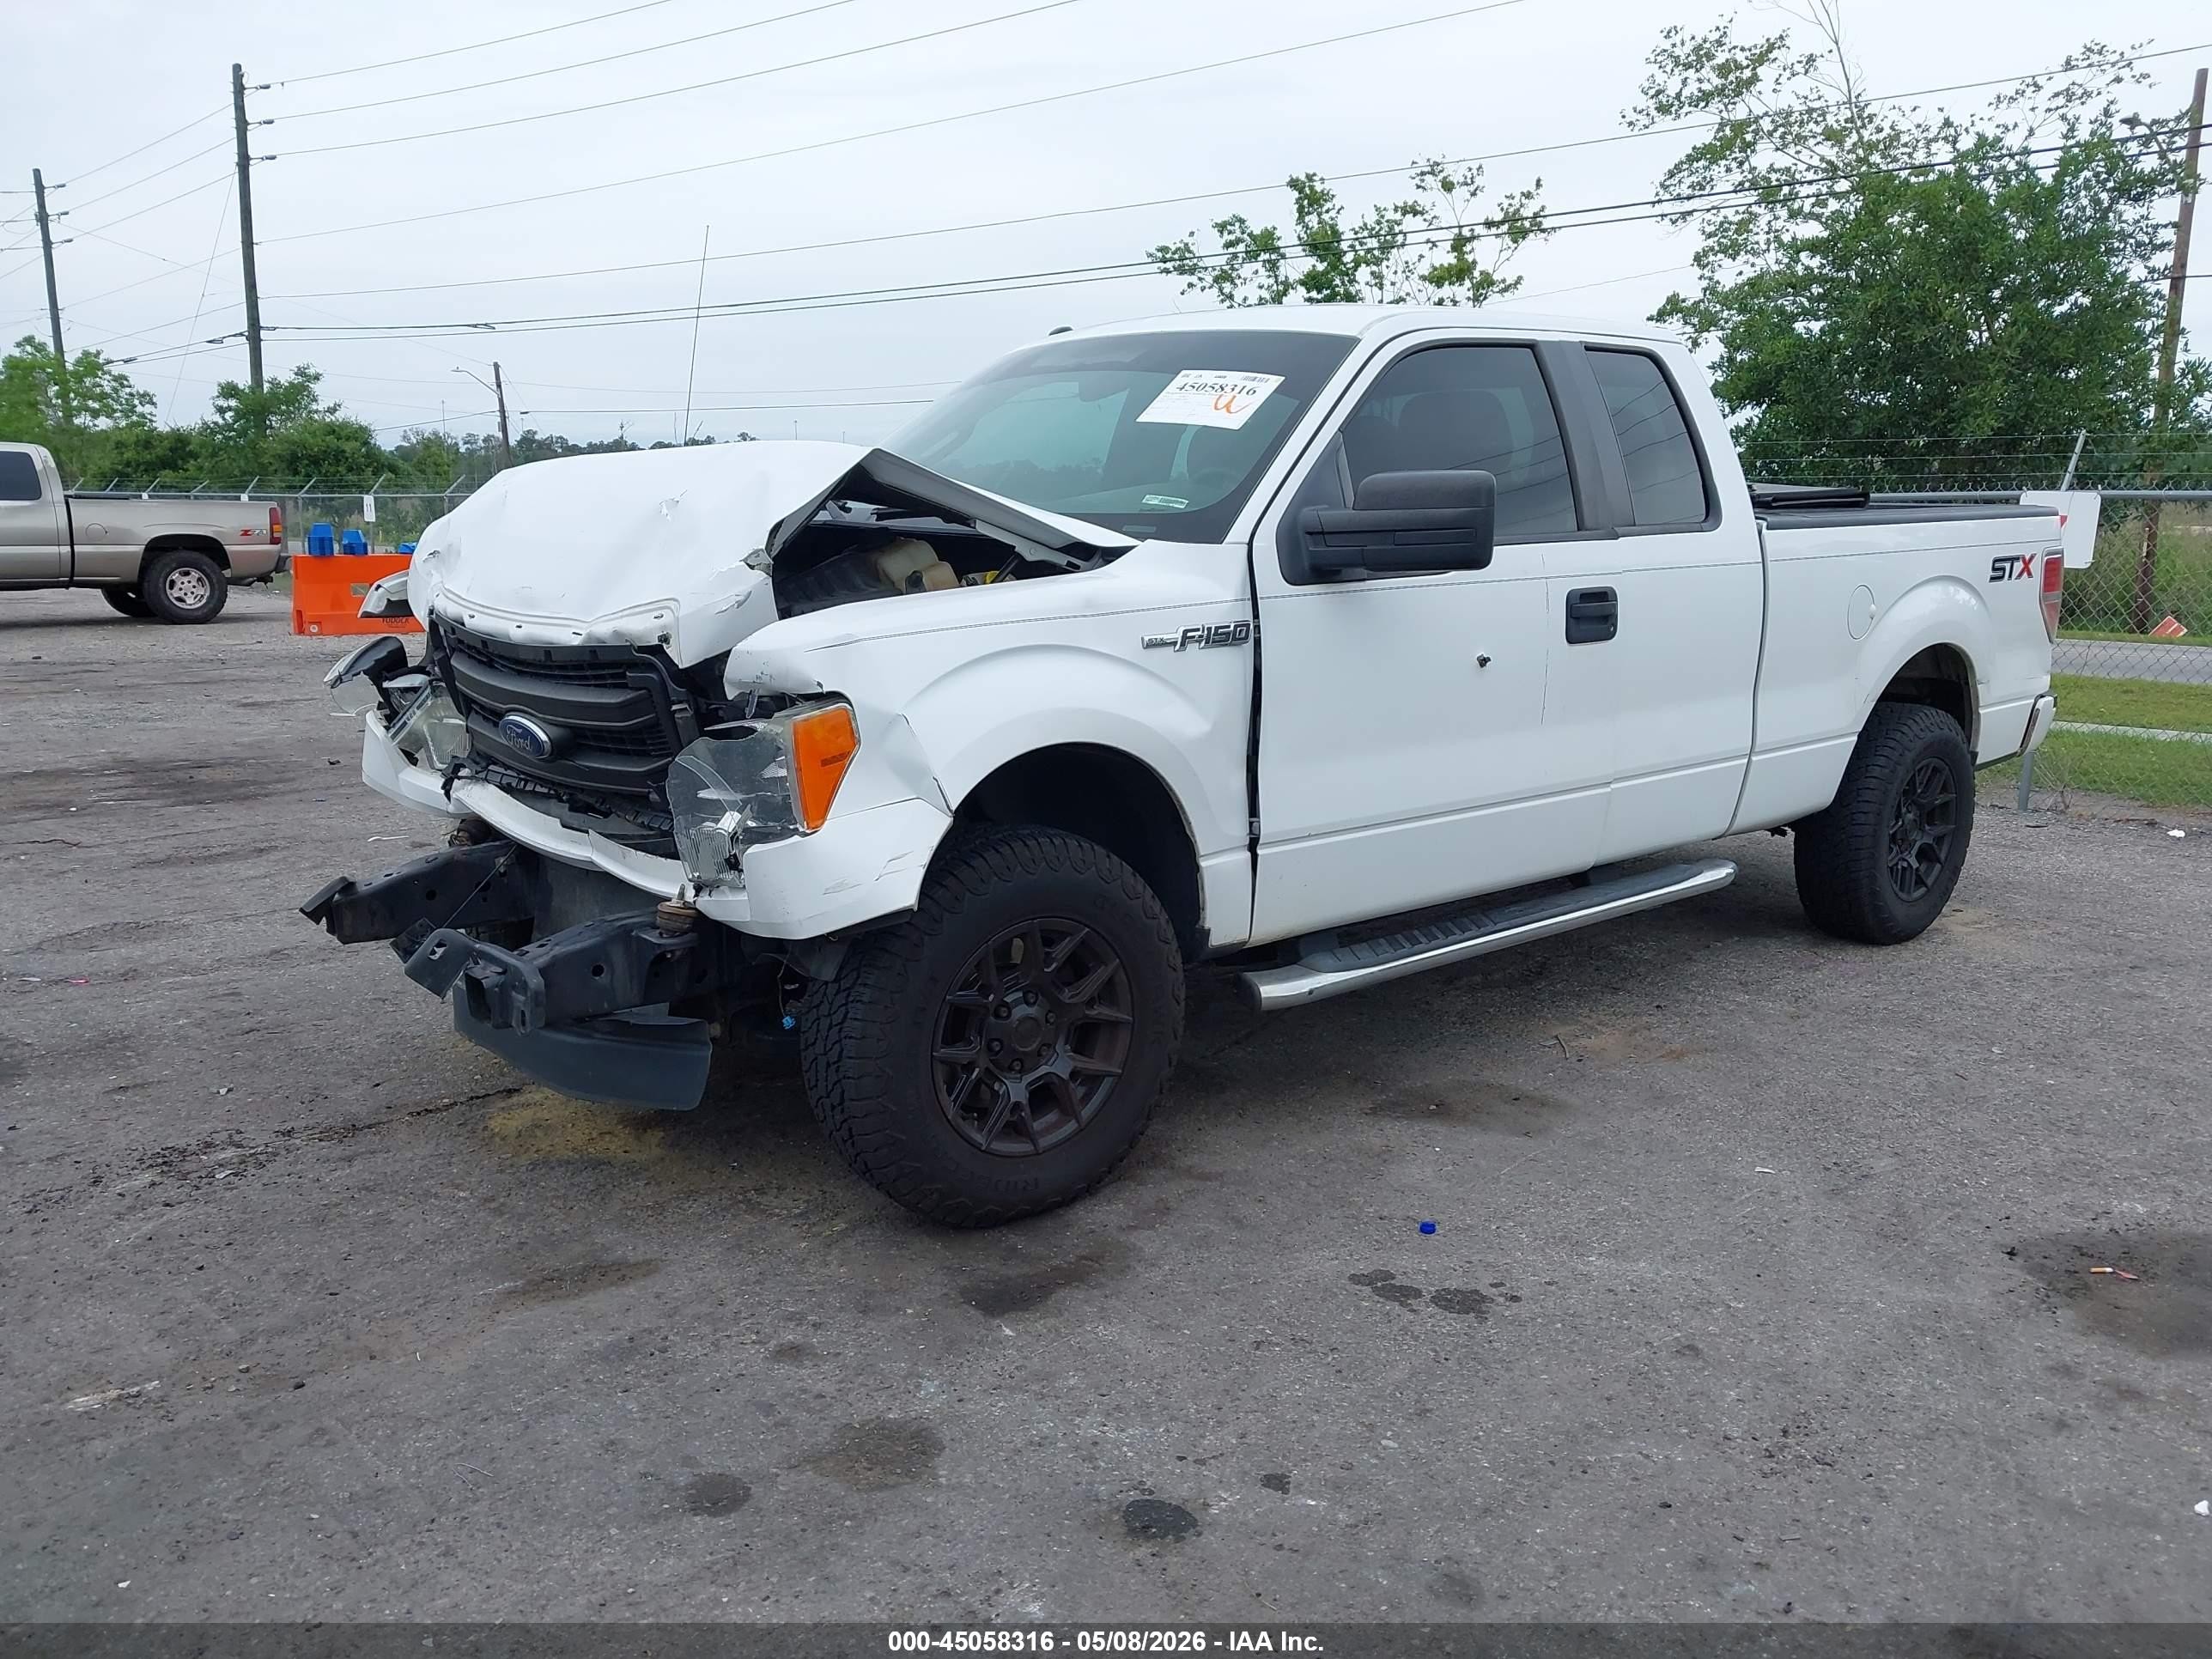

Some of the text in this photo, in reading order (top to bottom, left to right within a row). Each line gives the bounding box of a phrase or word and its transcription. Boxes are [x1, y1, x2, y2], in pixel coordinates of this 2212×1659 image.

[1176, 381, 1259, 396] 45058316
[1988, 553, 2037, 583] STX
[1175, 620, 1252, 651] F-150
[506, 724, 533, 750] Ford
